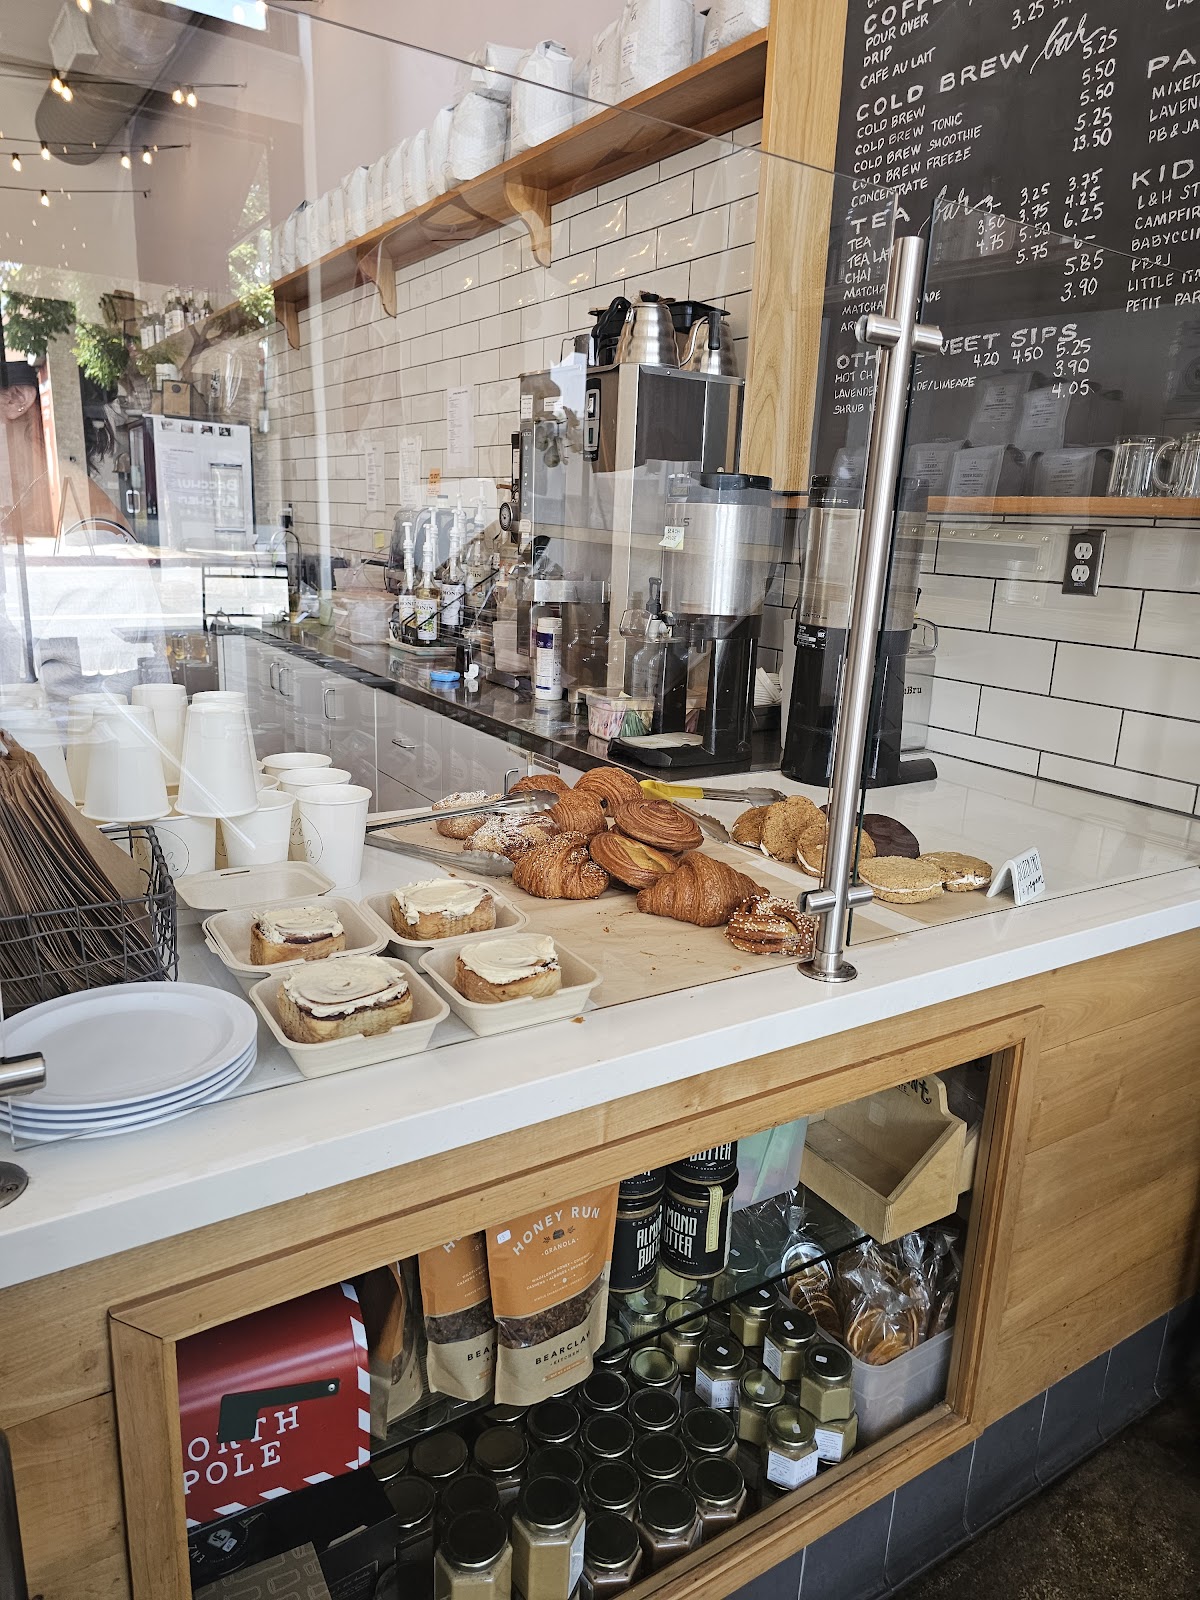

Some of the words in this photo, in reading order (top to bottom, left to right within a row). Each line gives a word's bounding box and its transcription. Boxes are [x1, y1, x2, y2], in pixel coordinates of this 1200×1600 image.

[863, 0, 941, 34] COFF
[1011, 1, 1045, 30] 3.25
[866, 26, 896, 51] POUR
[900, 13, 929, 36] OVER
[1083, 29, 1118, 60] 5.25
[860, 66, 889, 89] CAFE
[892, 60, 908, 76] AU
[911, 47, 936, 69] LAIT
[863, 45, 893, 67] DRIP
[856, 85, 924, 121] COLD
[940, 44, 1029, 92] BREW
[1081, 58, 1116, 86] 5.50
[1079, 81, 1114, 106] 5.50
[1152, 73, 1200, 100] MIXED
[857, 119, 888, 138] COLD
[891, 105, 925, 128] BREW
[1074, 106, 1113, 131] 5.25
[1149, 95, 1200, 123] LAVEN
[855, 138, 885, 156] COLD
[888, 125, 924, 145] BREW
[930, 112, 963, 132] TONIC
[1072, 127, 1112, 152] 13.50
[854, 155, 883, 173] COLD
[886, 143, 922, 164] BREW
[927, 125, 983, 152] SMOOTHIE
[886, 162, 921, 182] BREW
[926, 147, 971, 170] FREEZE
[851, 177, 929, 208] CONCENTRATE
[1020, 182, 1051, 206] 3.25
[1068, 167, 1103, 192] 3.75
[850, 206, 911, 235] TEA
[977, 214, 1006, 235] 3.50
[1018, 201, 1051, 224] 3.75
[1064, 186, 1101, 208] 4.25
[1134, 205, 1200, 230] CAMPFIR
[976, 231, 1006, 255] 4.75
[1018, 222, 1051, 243] 5.50
[1063, 202, 1104, 229] 6.25
[847, 237, 871, 252] TEA
[1015, 241, 1049, 265] 5.75
[847, 252, 871, 269] TEA
[1063, 249, 1104, 275] 5.85
[845, 267, 871, 284] CHAI
[1060, 277, 1098, 302] 3.90
[1128, 273, 1174, 292] LITTLE
[843, 283, 886, 300] MATCHA
[1126, 296, 1162, 313] PETIT
[1011, 323, 1077, 348] SIPS
[834, 371, 856, 384] HOT
[973, 350, 1000, 369] 4.20
[1012, 346, 1044, 364] 4.50
[1056, 338, 1092, 359] 5.25
[1053, 357, 1090, 377] 3.90
[833, 403, 865, 415] SHRUB
[1051, 378, 1090, 398] 4.05
[512, 1209, 563, 1256] HONEY
[571, 1206, 600, 1219] RUN
[544, 1239, 577, 1256] GRANOLA
[183, 1441, 281, 1495] POLE
